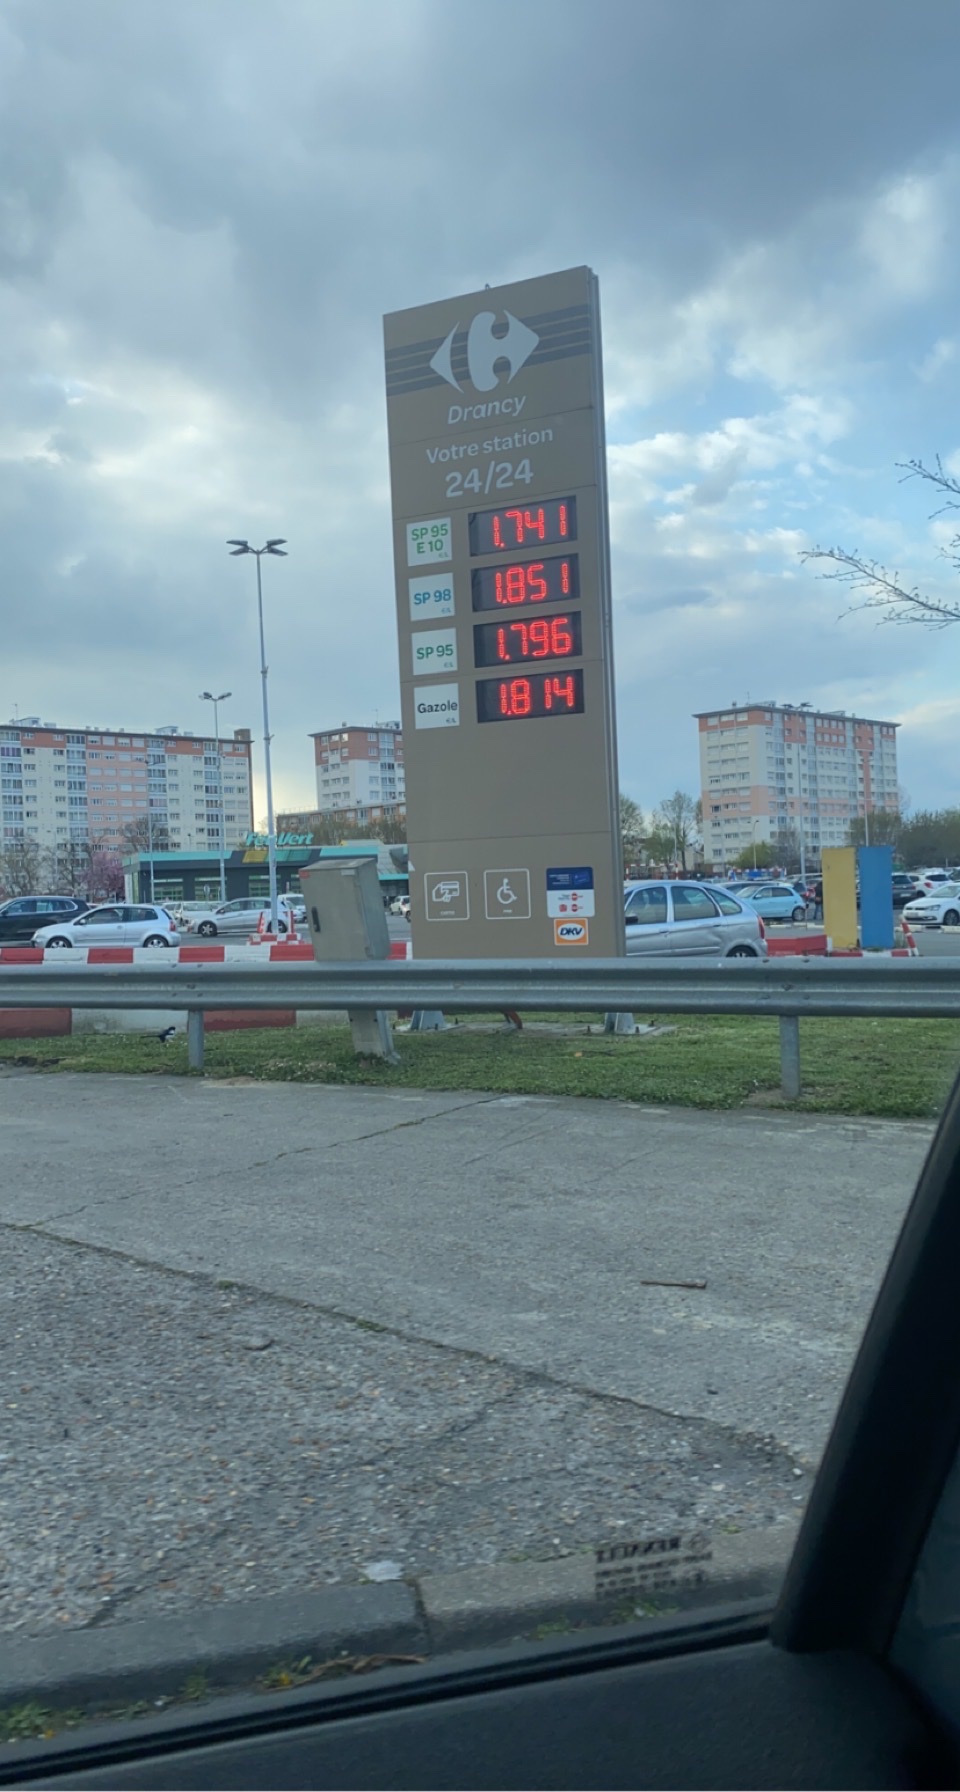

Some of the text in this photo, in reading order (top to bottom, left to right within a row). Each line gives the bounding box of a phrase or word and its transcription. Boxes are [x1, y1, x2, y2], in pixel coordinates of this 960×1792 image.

[448, 395, 526, 424] Drancy
[426, 429, 553, 464] Votre station
[445, 458, 534, 498] 24/24
[411, 523, 449, 542] SP 95
[416, 538, 444, 554] E 10
[413, 588, 452, 605] SP 98
[416, 643, 454, 660] SP 95
[417, 700, 458, 714] Gazole
[277, 831, 314, 846] Vert
[560, 927, 583, 936] DKV
